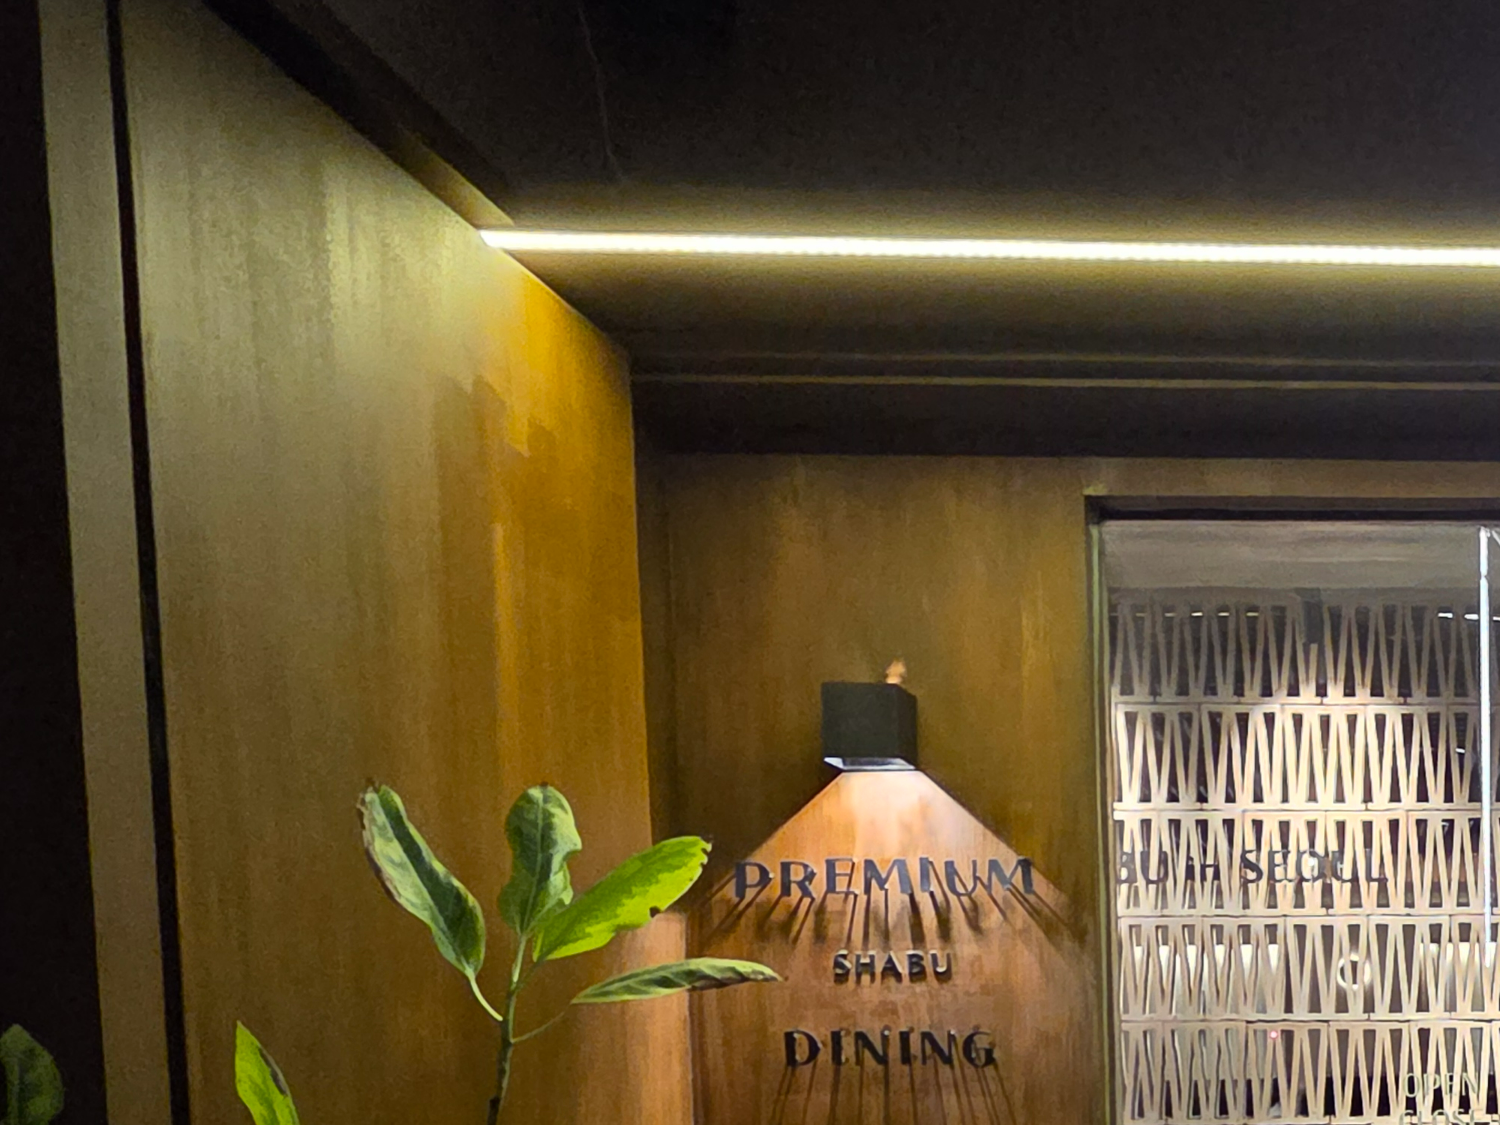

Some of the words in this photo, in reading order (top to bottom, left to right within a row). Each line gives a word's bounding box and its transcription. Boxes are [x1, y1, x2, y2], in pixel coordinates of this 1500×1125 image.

[734, 856, 1036, 900] PREMIUM
[1240, 849, 1389, 885] SEOUL
[832, 949, 953, 981] SHABU
[783, 1029, 998, 1068] DINING
[1403, 1072, 1480, 1098] OPEN
